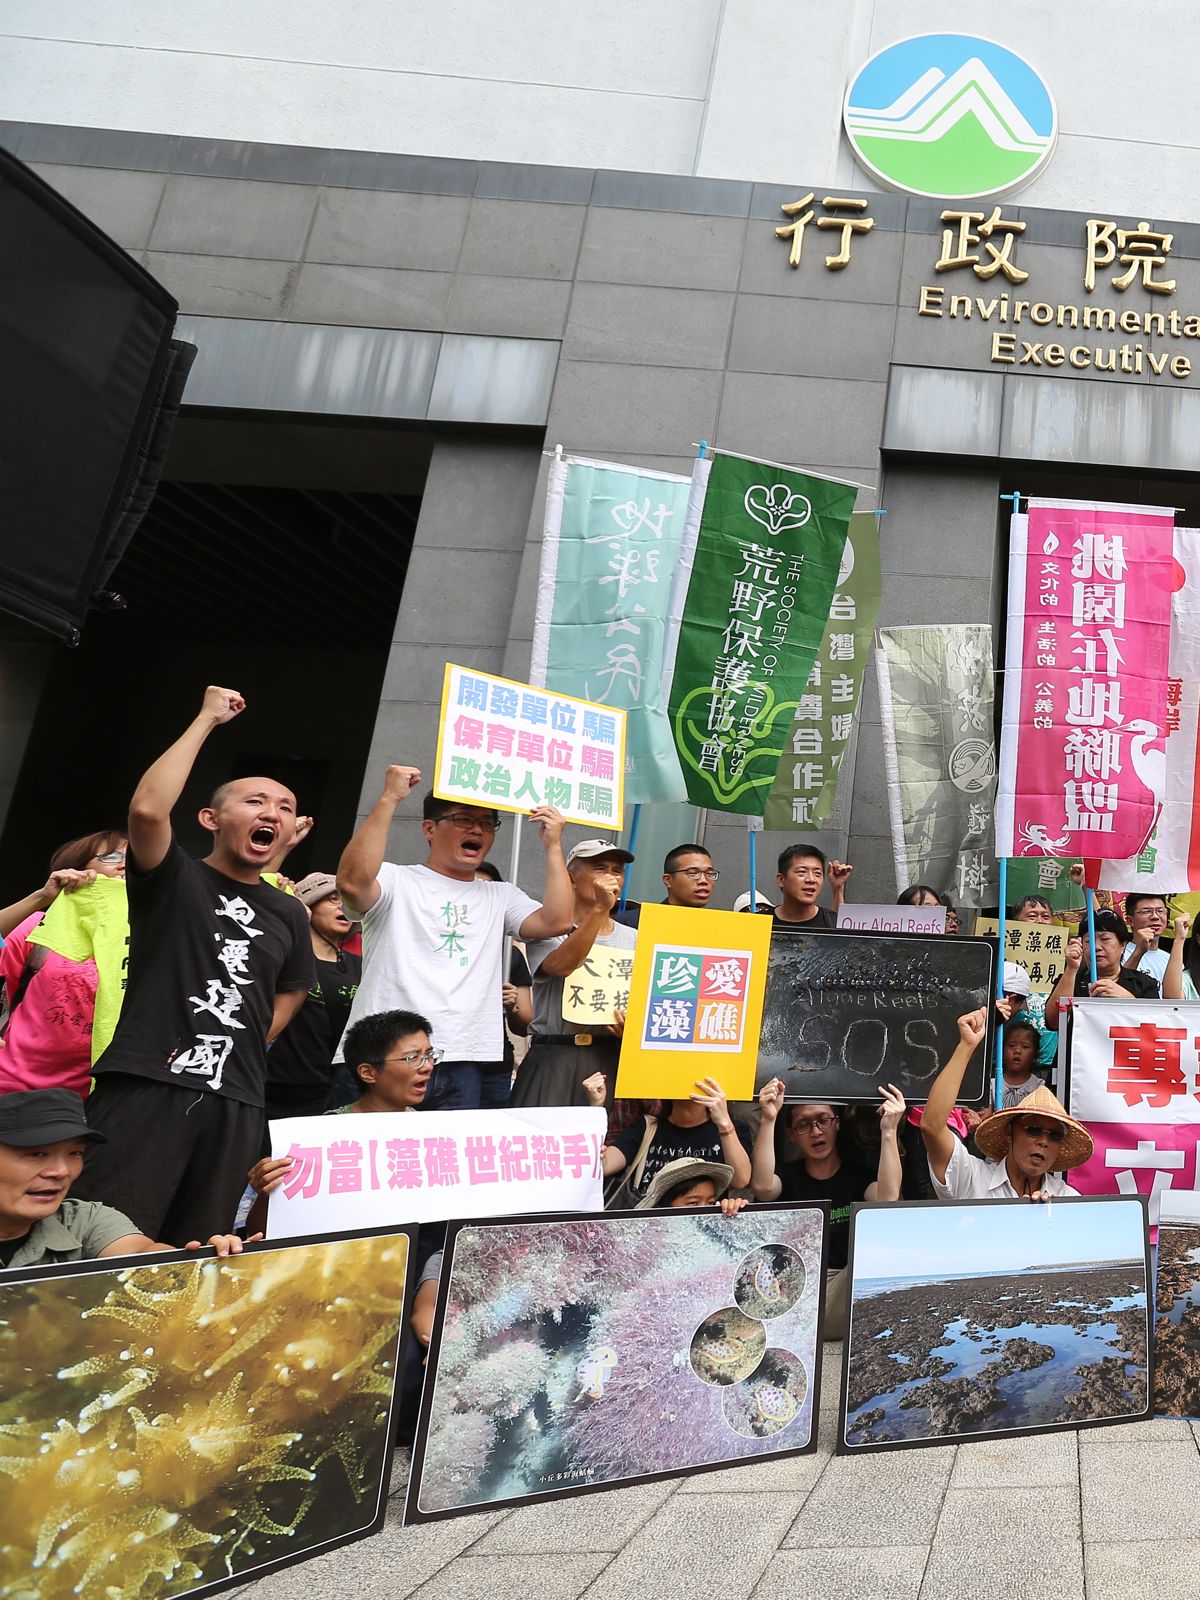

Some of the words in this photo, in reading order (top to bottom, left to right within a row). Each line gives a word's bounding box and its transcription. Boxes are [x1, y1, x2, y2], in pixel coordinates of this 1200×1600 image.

[990, 330, 1192, 379] Executive
[786, 553, 805, 581] THE
[768, 585, 797, 651] SOCIETY
[698, 541, 786, 773] 荒野保護協會
[760, 654, 778, 676] OF
[829, 594, 856, 769] 台灣主婦
[456, 675, 577, 734] 開發單位
[581, 710, 616, 745] 騙
[730, 681, 769, 777] WILDERNESS
[453, 714, 574, 772] 保育單位
[580, 745, 615, 782] 騙
[448, 755, 572, 810] 政治人物
[577, 782, 613, 818] 騙
[434, 901, 472, 959] 根本
[842, 917, 868, 930] Our
[871, 917, 904, 933] Algal
[907, 919, 941, 935] Reefs
[654, 955, 748, 999] 珍愛
[649, 1002, 741, 1043] 藻礁
[787, 1014, 940, 1080] SOS
